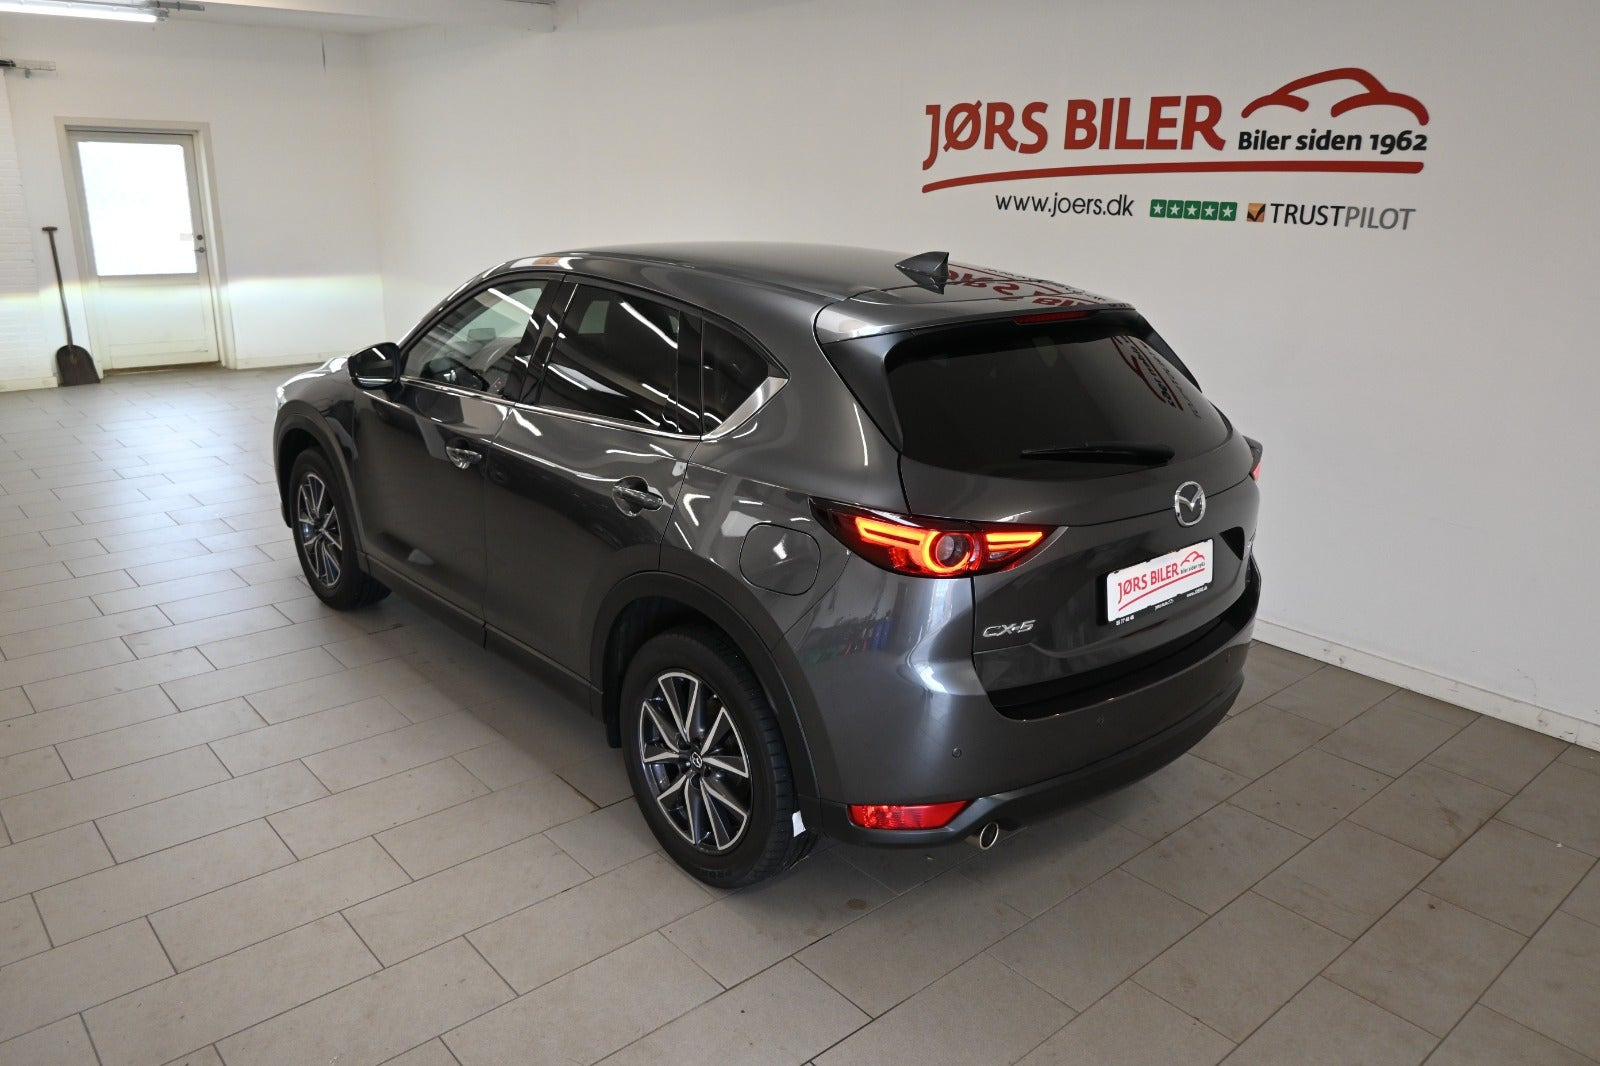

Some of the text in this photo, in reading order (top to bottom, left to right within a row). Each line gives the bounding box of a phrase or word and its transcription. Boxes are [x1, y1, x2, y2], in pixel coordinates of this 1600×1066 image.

[922, 95, 1226, 171] JØRS BILER
[1238, 128, 1427, 155] Biler siden 1962
[995, 193, 1134, 217] www.joers.dk
[1270, 203, 1416, 230] TRUSTPILOT
[1118, 563, 1179, 604] JØRS BILER
[982, 619, 1036, 637] CX-5
